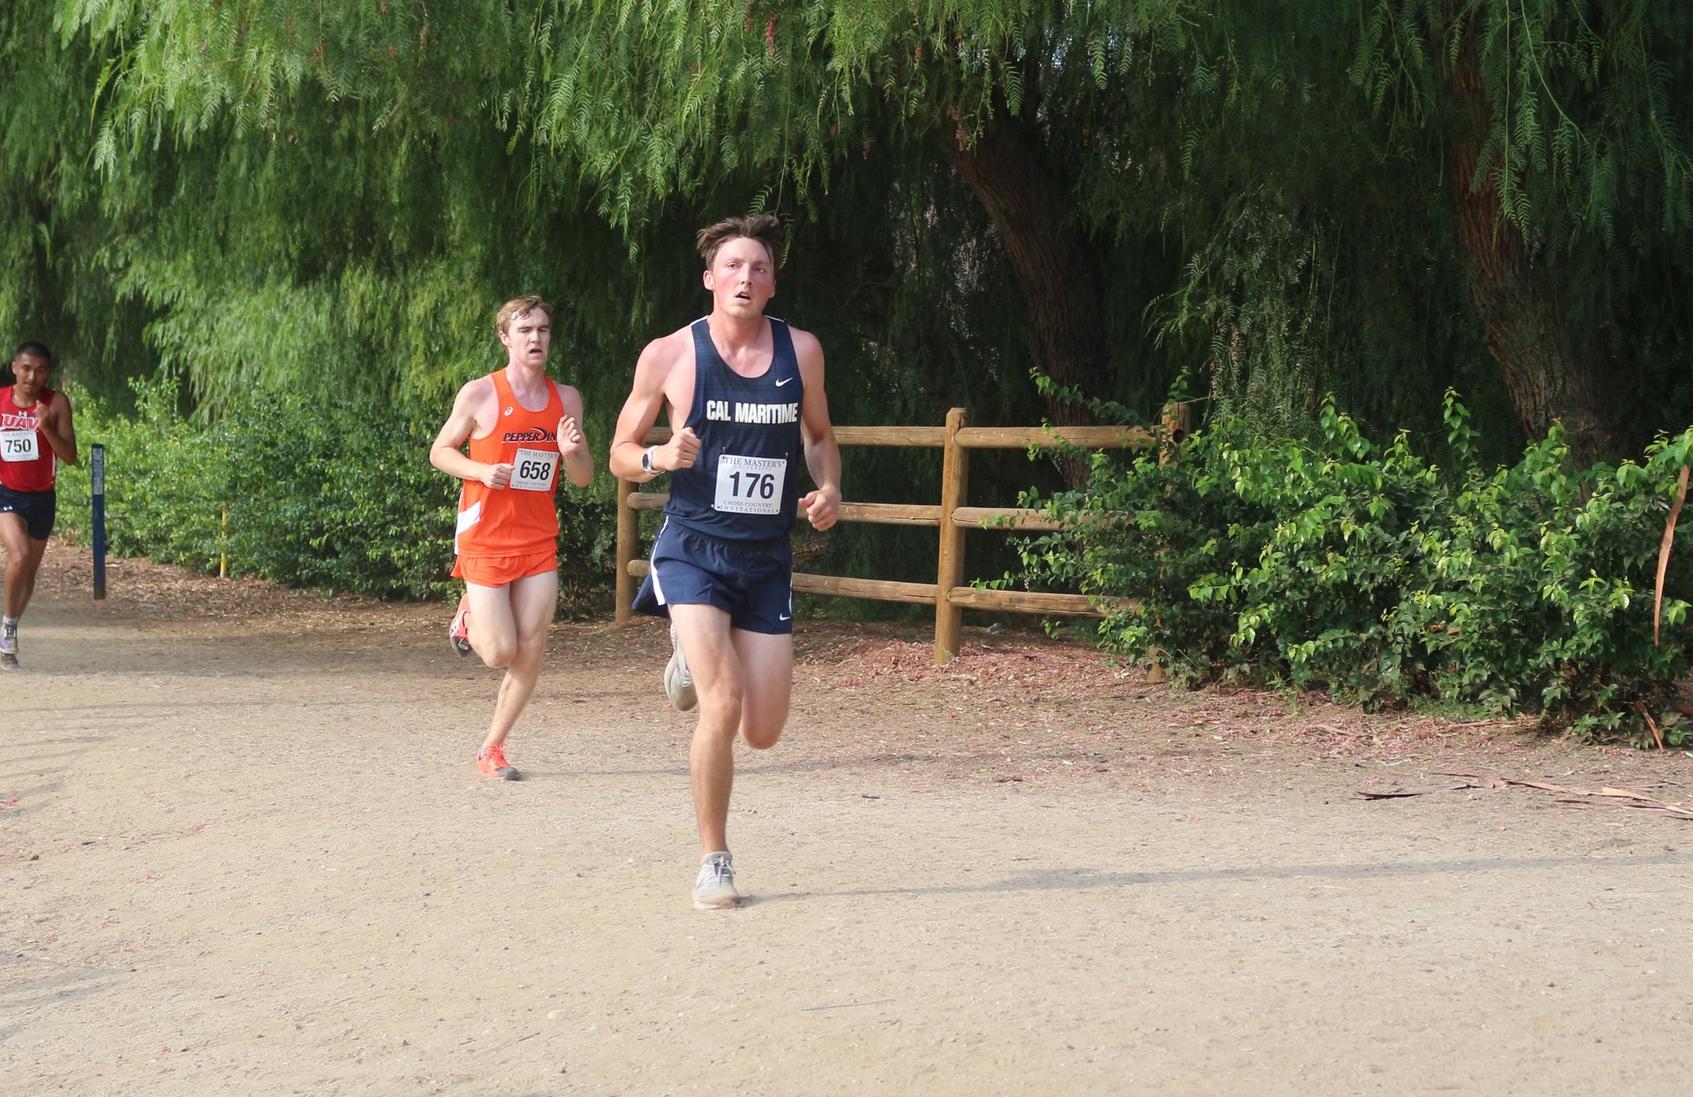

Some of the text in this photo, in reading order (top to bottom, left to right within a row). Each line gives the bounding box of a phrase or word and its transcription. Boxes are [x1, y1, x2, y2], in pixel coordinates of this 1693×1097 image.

[707, 400, 799, 424] CAL MARITIME
[504, 427, 557, 441] PEPPERDIN
[5, 439, 31, 453] 750
[725, 457, 743, 465] THE
[744, 459, 782, 468] MASTER'S
[520, 460, 551, 481] 658
[729, 471, 775, 499] 176
[720, 504, 775, 513] INVITATIONAL
